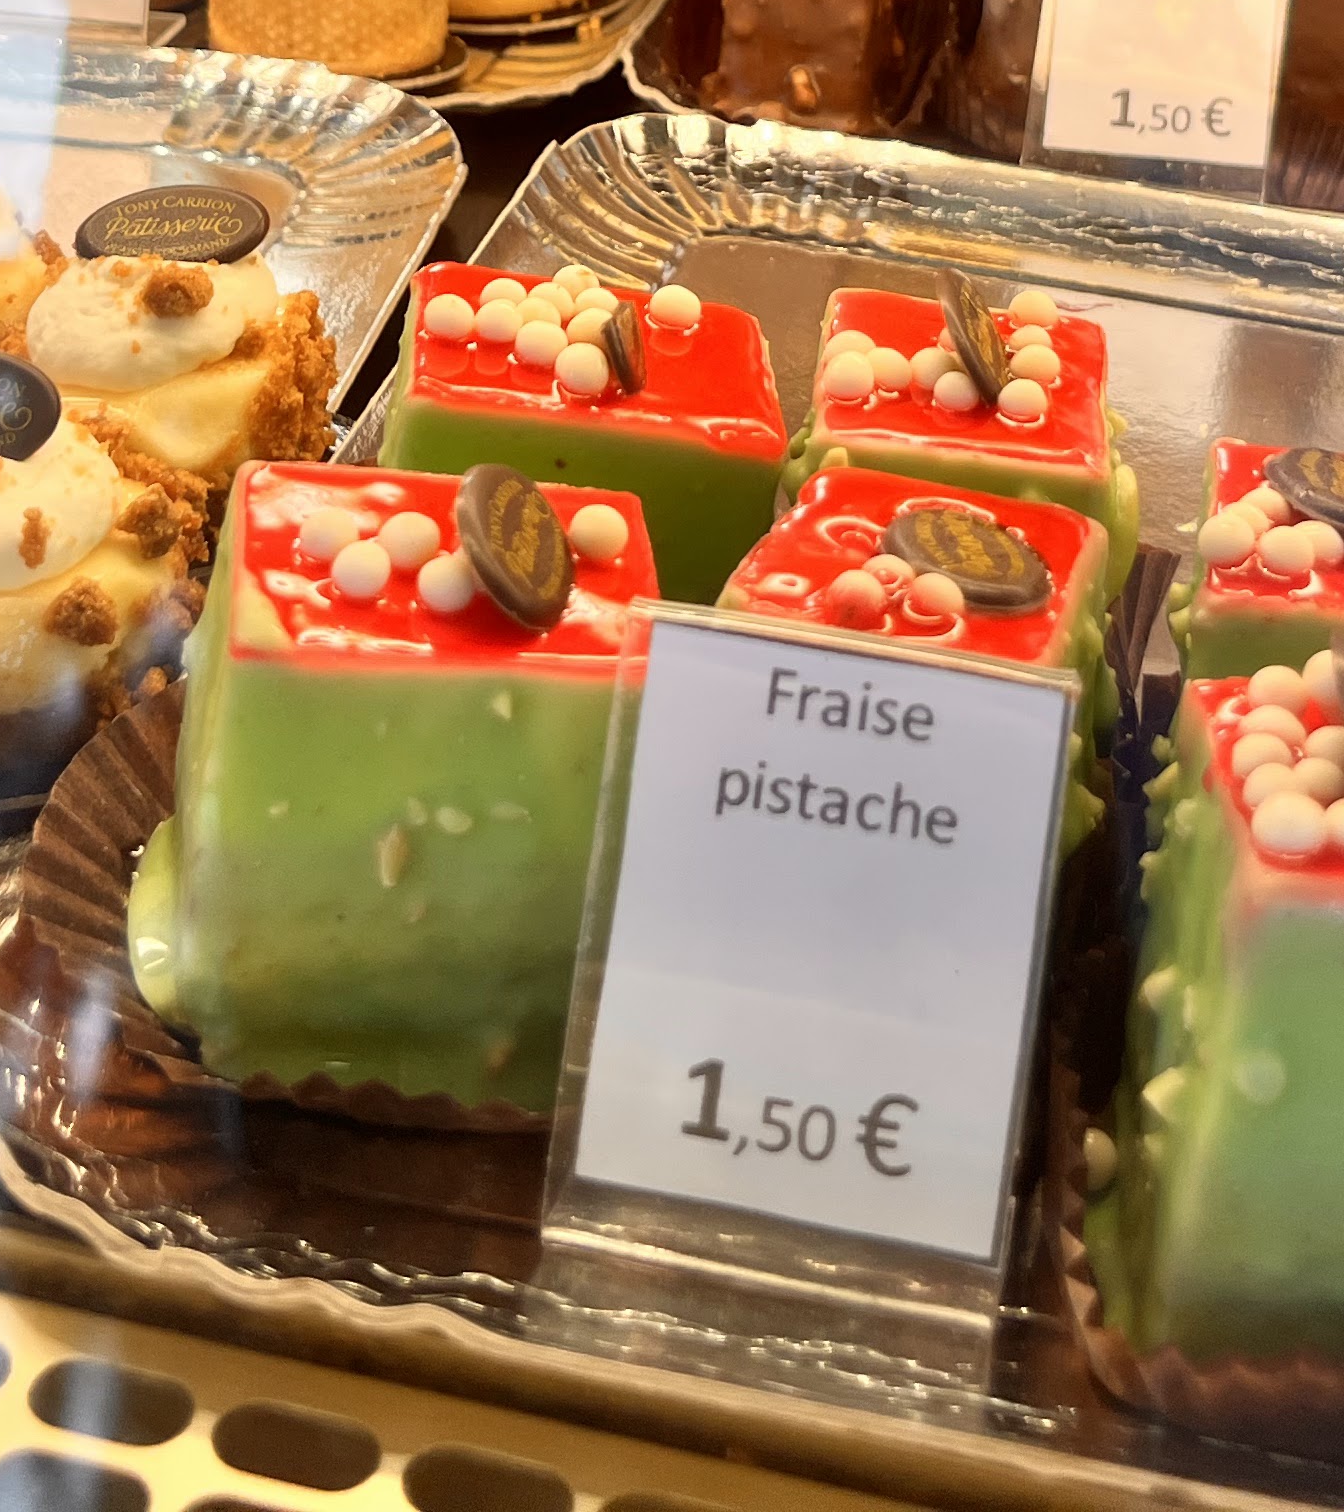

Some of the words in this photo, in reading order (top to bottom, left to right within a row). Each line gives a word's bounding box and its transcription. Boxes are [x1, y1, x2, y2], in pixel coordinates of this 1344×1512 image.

[1109, 88, 1192, 135] 1,50
[1200, 96, 1234, 138] €
[104, 211, 244, 243] Patisserie
[115, 199, 161, 218] TONY
[162, 195, 237, 215] CARRION
[766, 666, 936, 743] Fraise
[714, 760, 959, 845] pistache
[680, 1057, 838, 1164] 1,50
[855, 1092, 920, 1178] €
